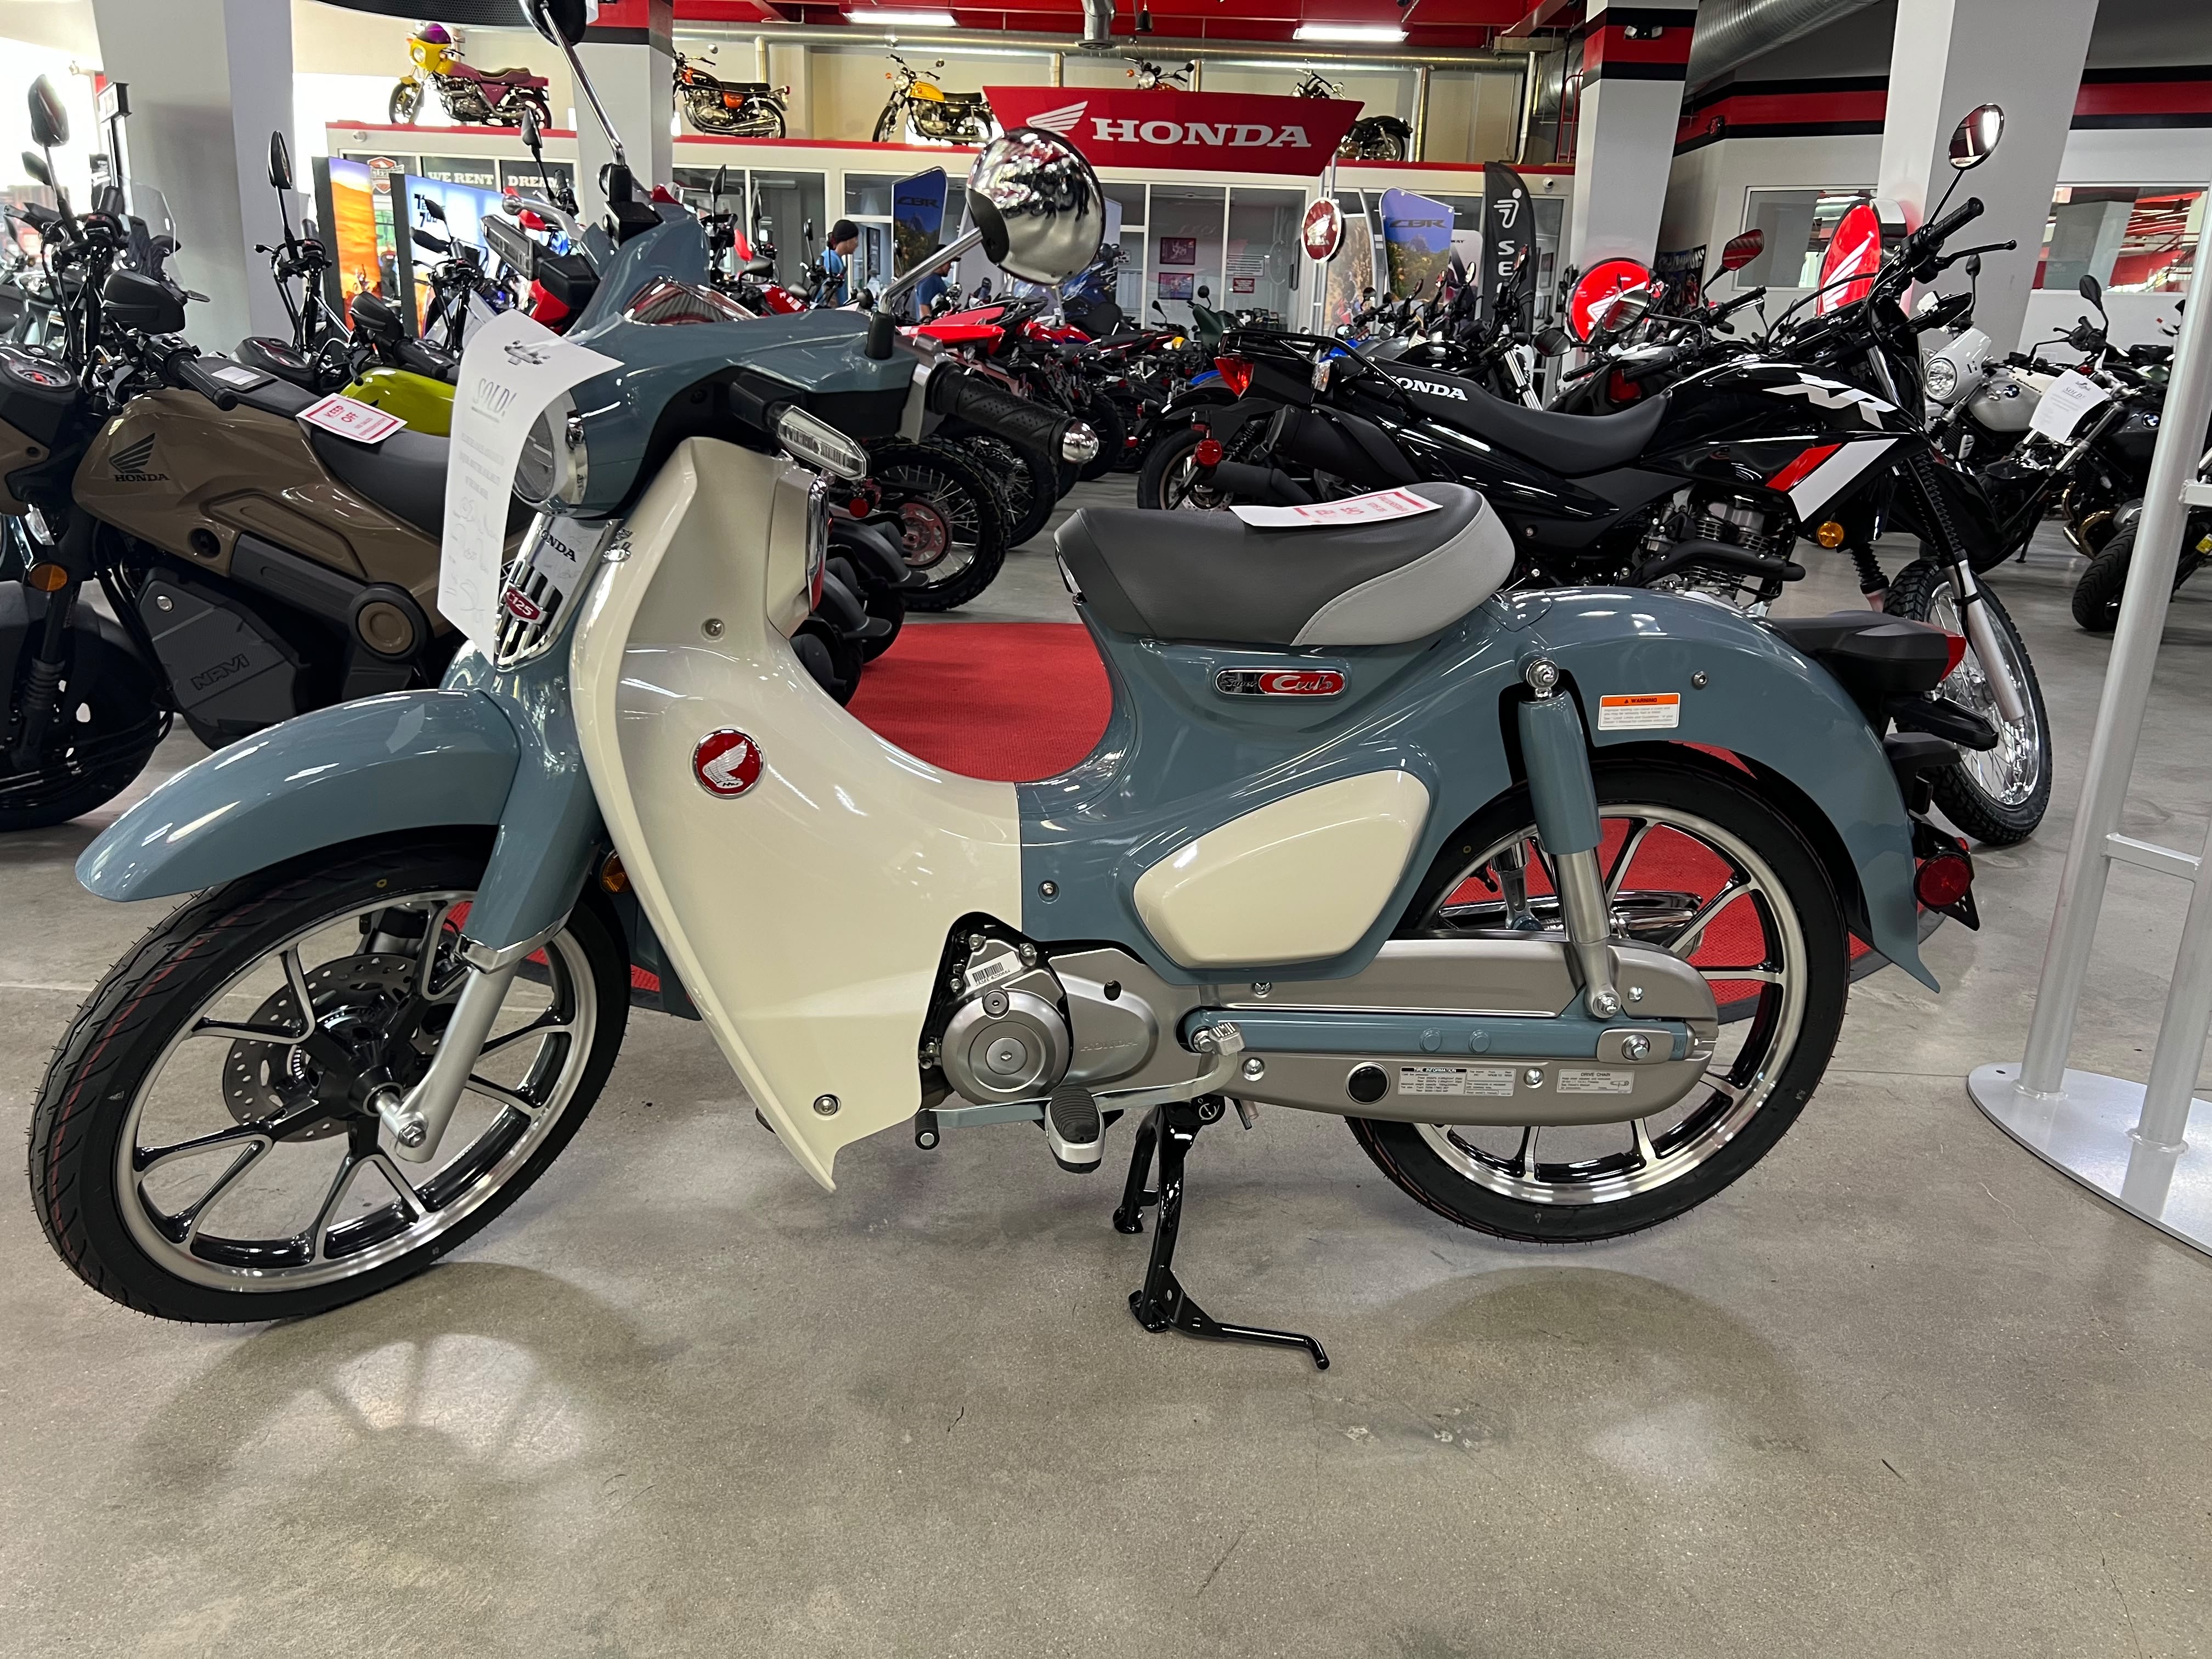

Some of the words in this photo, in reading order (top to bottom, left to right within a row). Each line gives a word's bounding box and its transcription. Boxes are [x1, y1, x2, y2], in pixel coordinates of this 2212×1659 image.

[1091, 117, 1312, 148] HONDA
[428, 172, 451, 183] WE
[453, 173, 494, 185] RENT
[507, 175, 569, 188] DREAM
[1390, 219, 1448, 229] CBR
[473, 378, 517, 417] SOLD!
[341, 412, 359, 422] OFF
[114, 473, 171, 482] HONDA
[1272, 675, 1333, 691] Cub
[1080, 1040, 1138, 1052] HONDA
